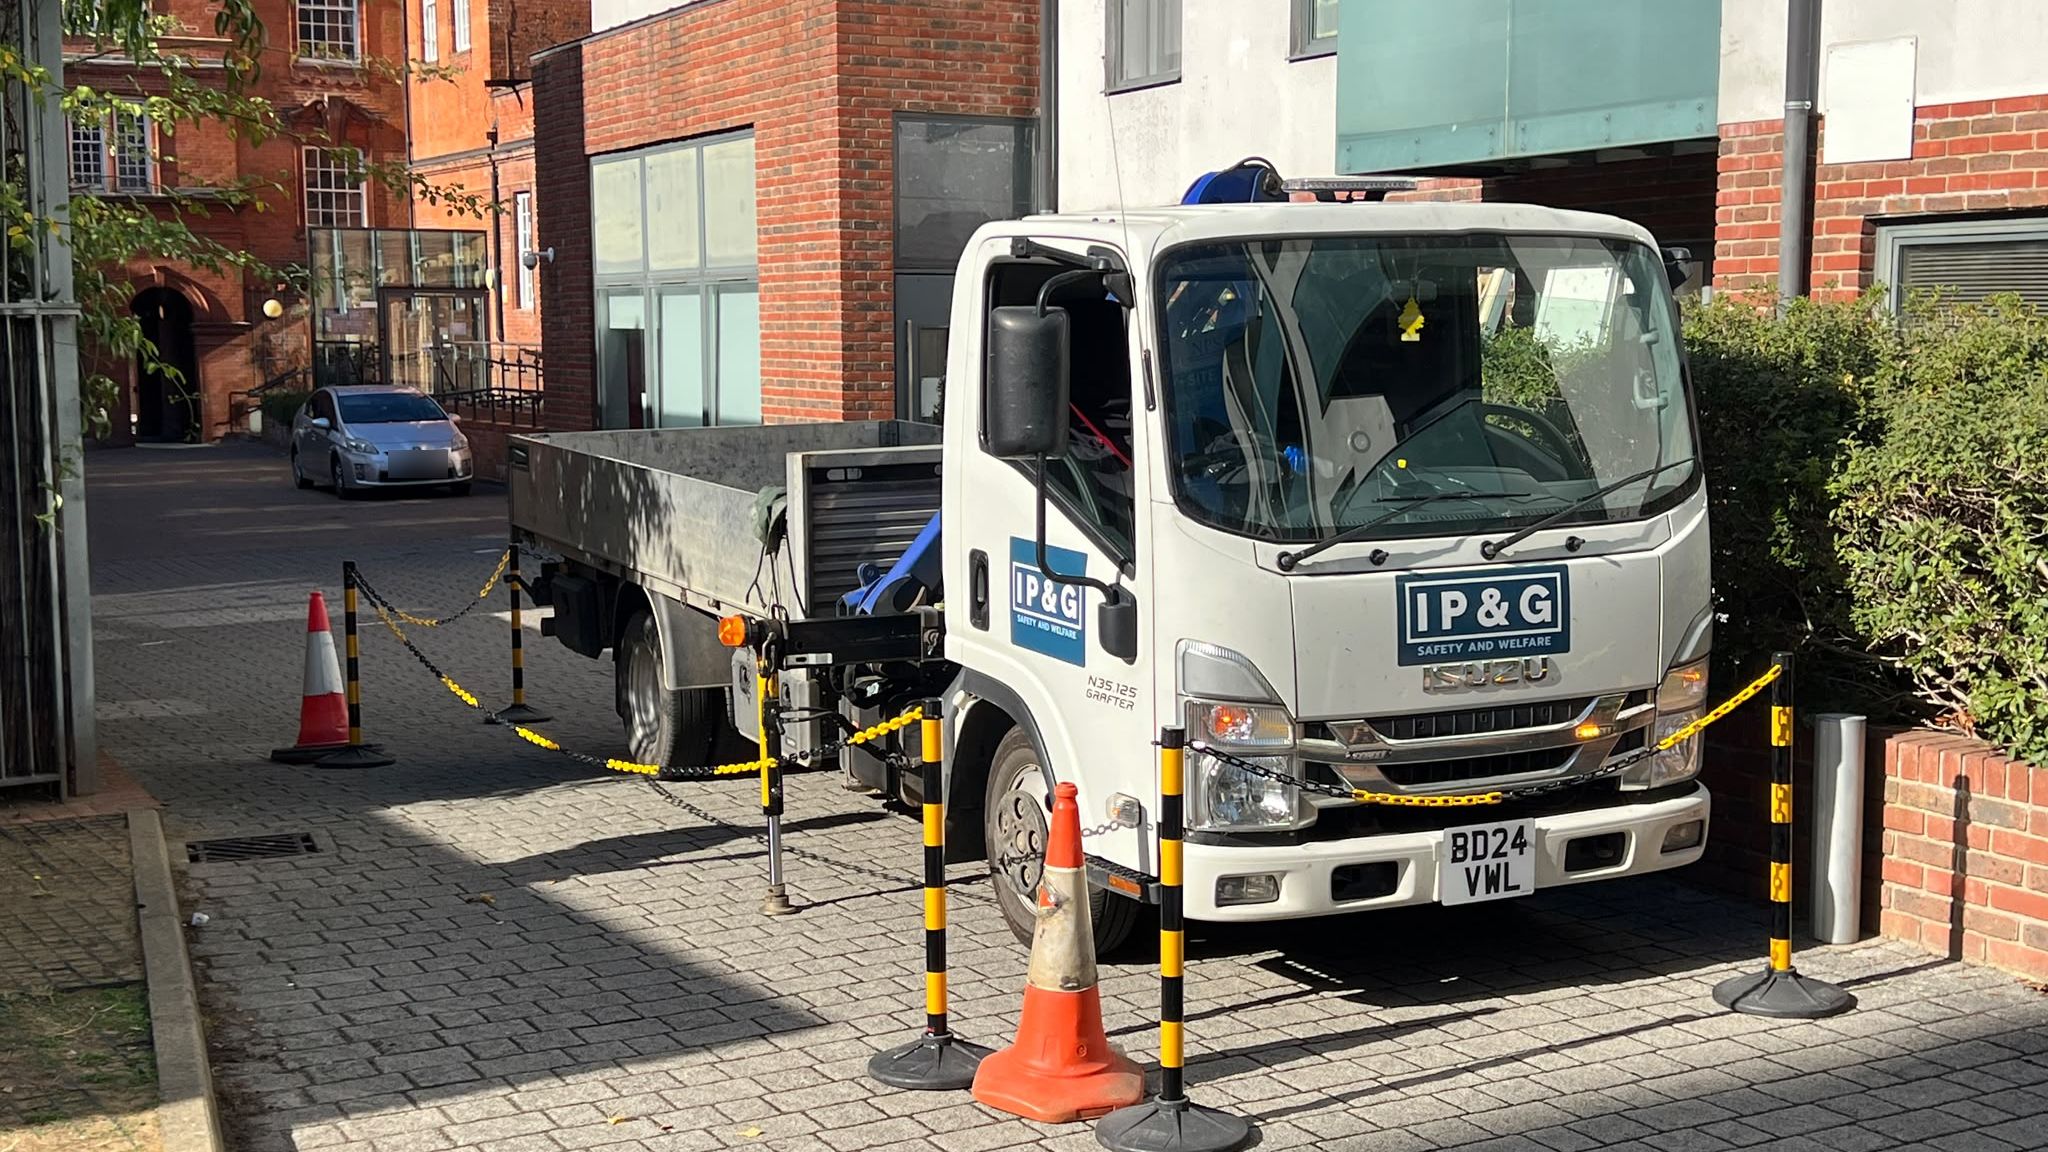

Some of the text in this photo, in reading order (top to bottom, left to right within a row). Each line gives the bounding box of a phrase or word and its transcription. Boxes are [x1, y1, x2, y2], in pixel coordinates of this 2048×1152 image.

[1016, 572, 1078, 620] IP&G
[1416, 584, 1552, 632] IP&G
[1017, 614, 1077, 640] SAFETY AND WELFARE
[1417, 636, 1552, 656] SAFETY AND WELFARE
[1423, 656, 1549, 691] ISUZU
[1086, 690, 1135, 711] GRAFTER
[1451, 825, 1528, 864] BD24
[1465, 862, 1520, 896] VWL
